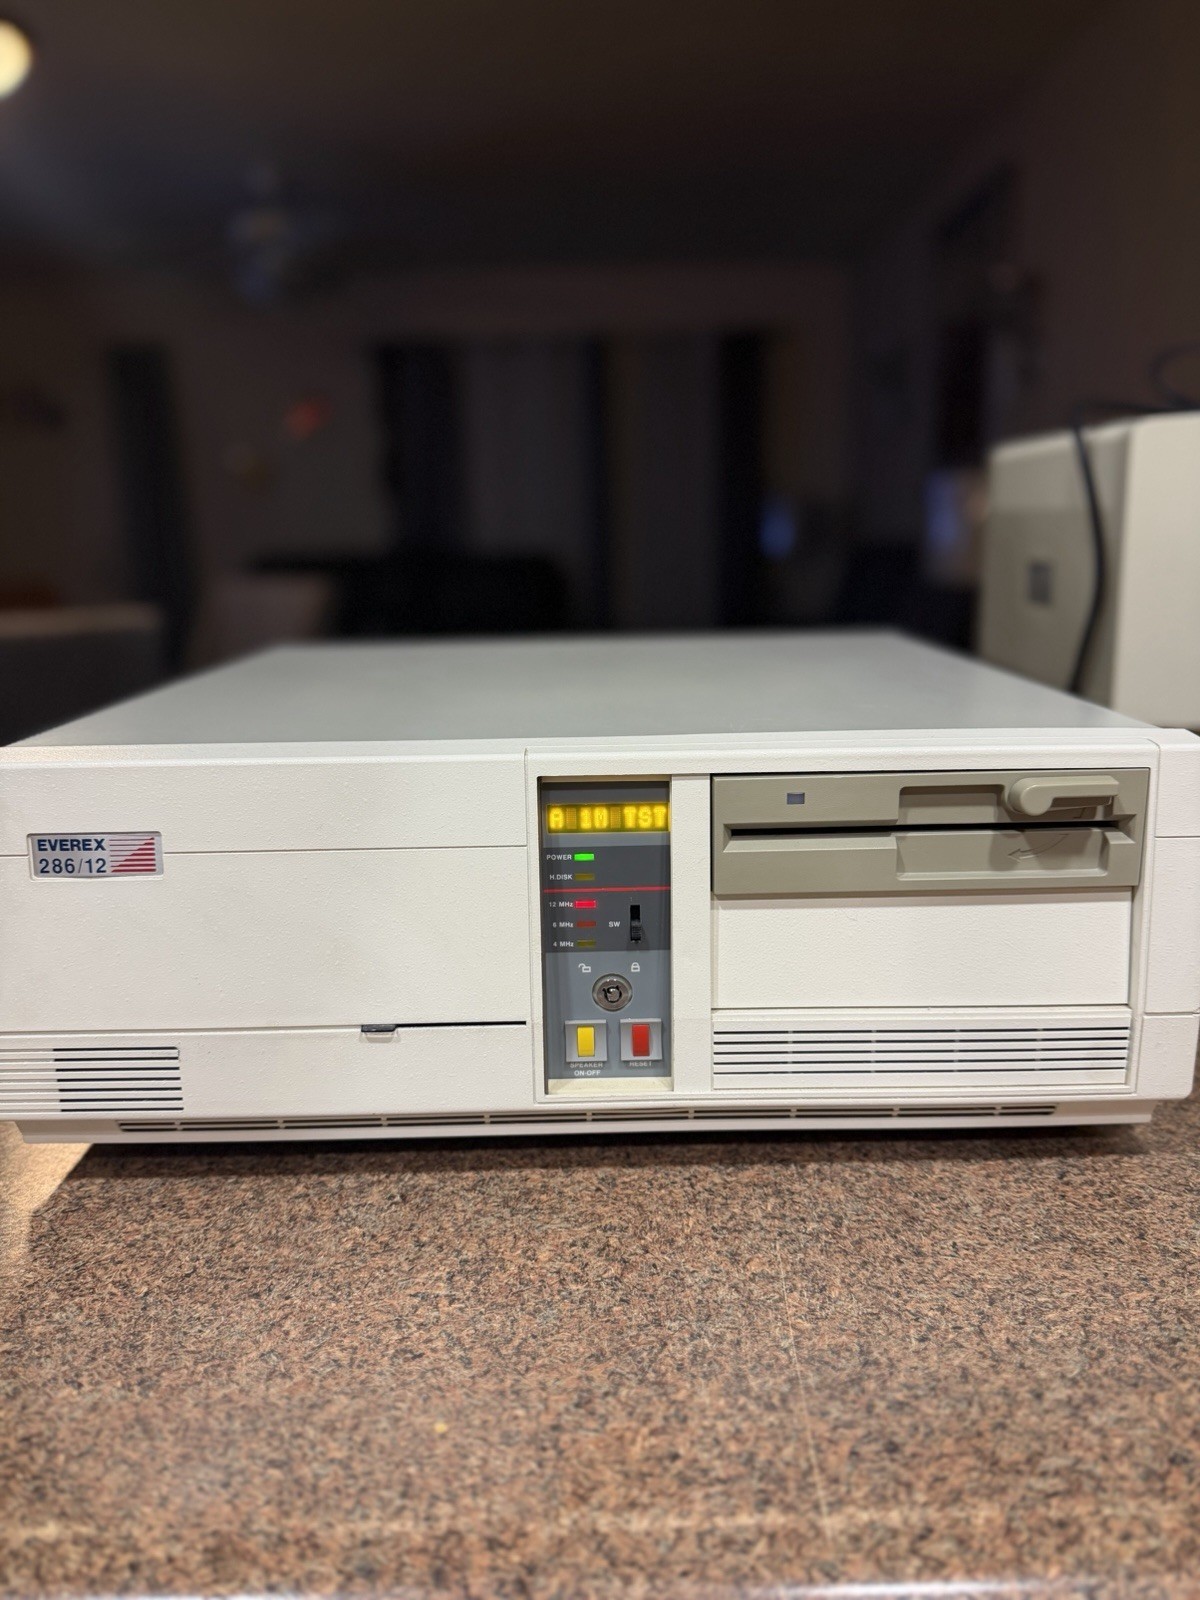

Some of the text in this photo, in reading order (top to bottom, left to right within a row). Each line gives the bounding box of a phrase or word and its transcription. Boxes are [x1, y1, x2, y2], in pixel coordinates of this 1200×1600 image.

[548, 807, 564, 829] A
[623, 804, 667, 828] TST
[37, 838, 107, 852] EVEREX
[39, 858, 107, 874] 286/12
[608, 920, 621, 928] SW
